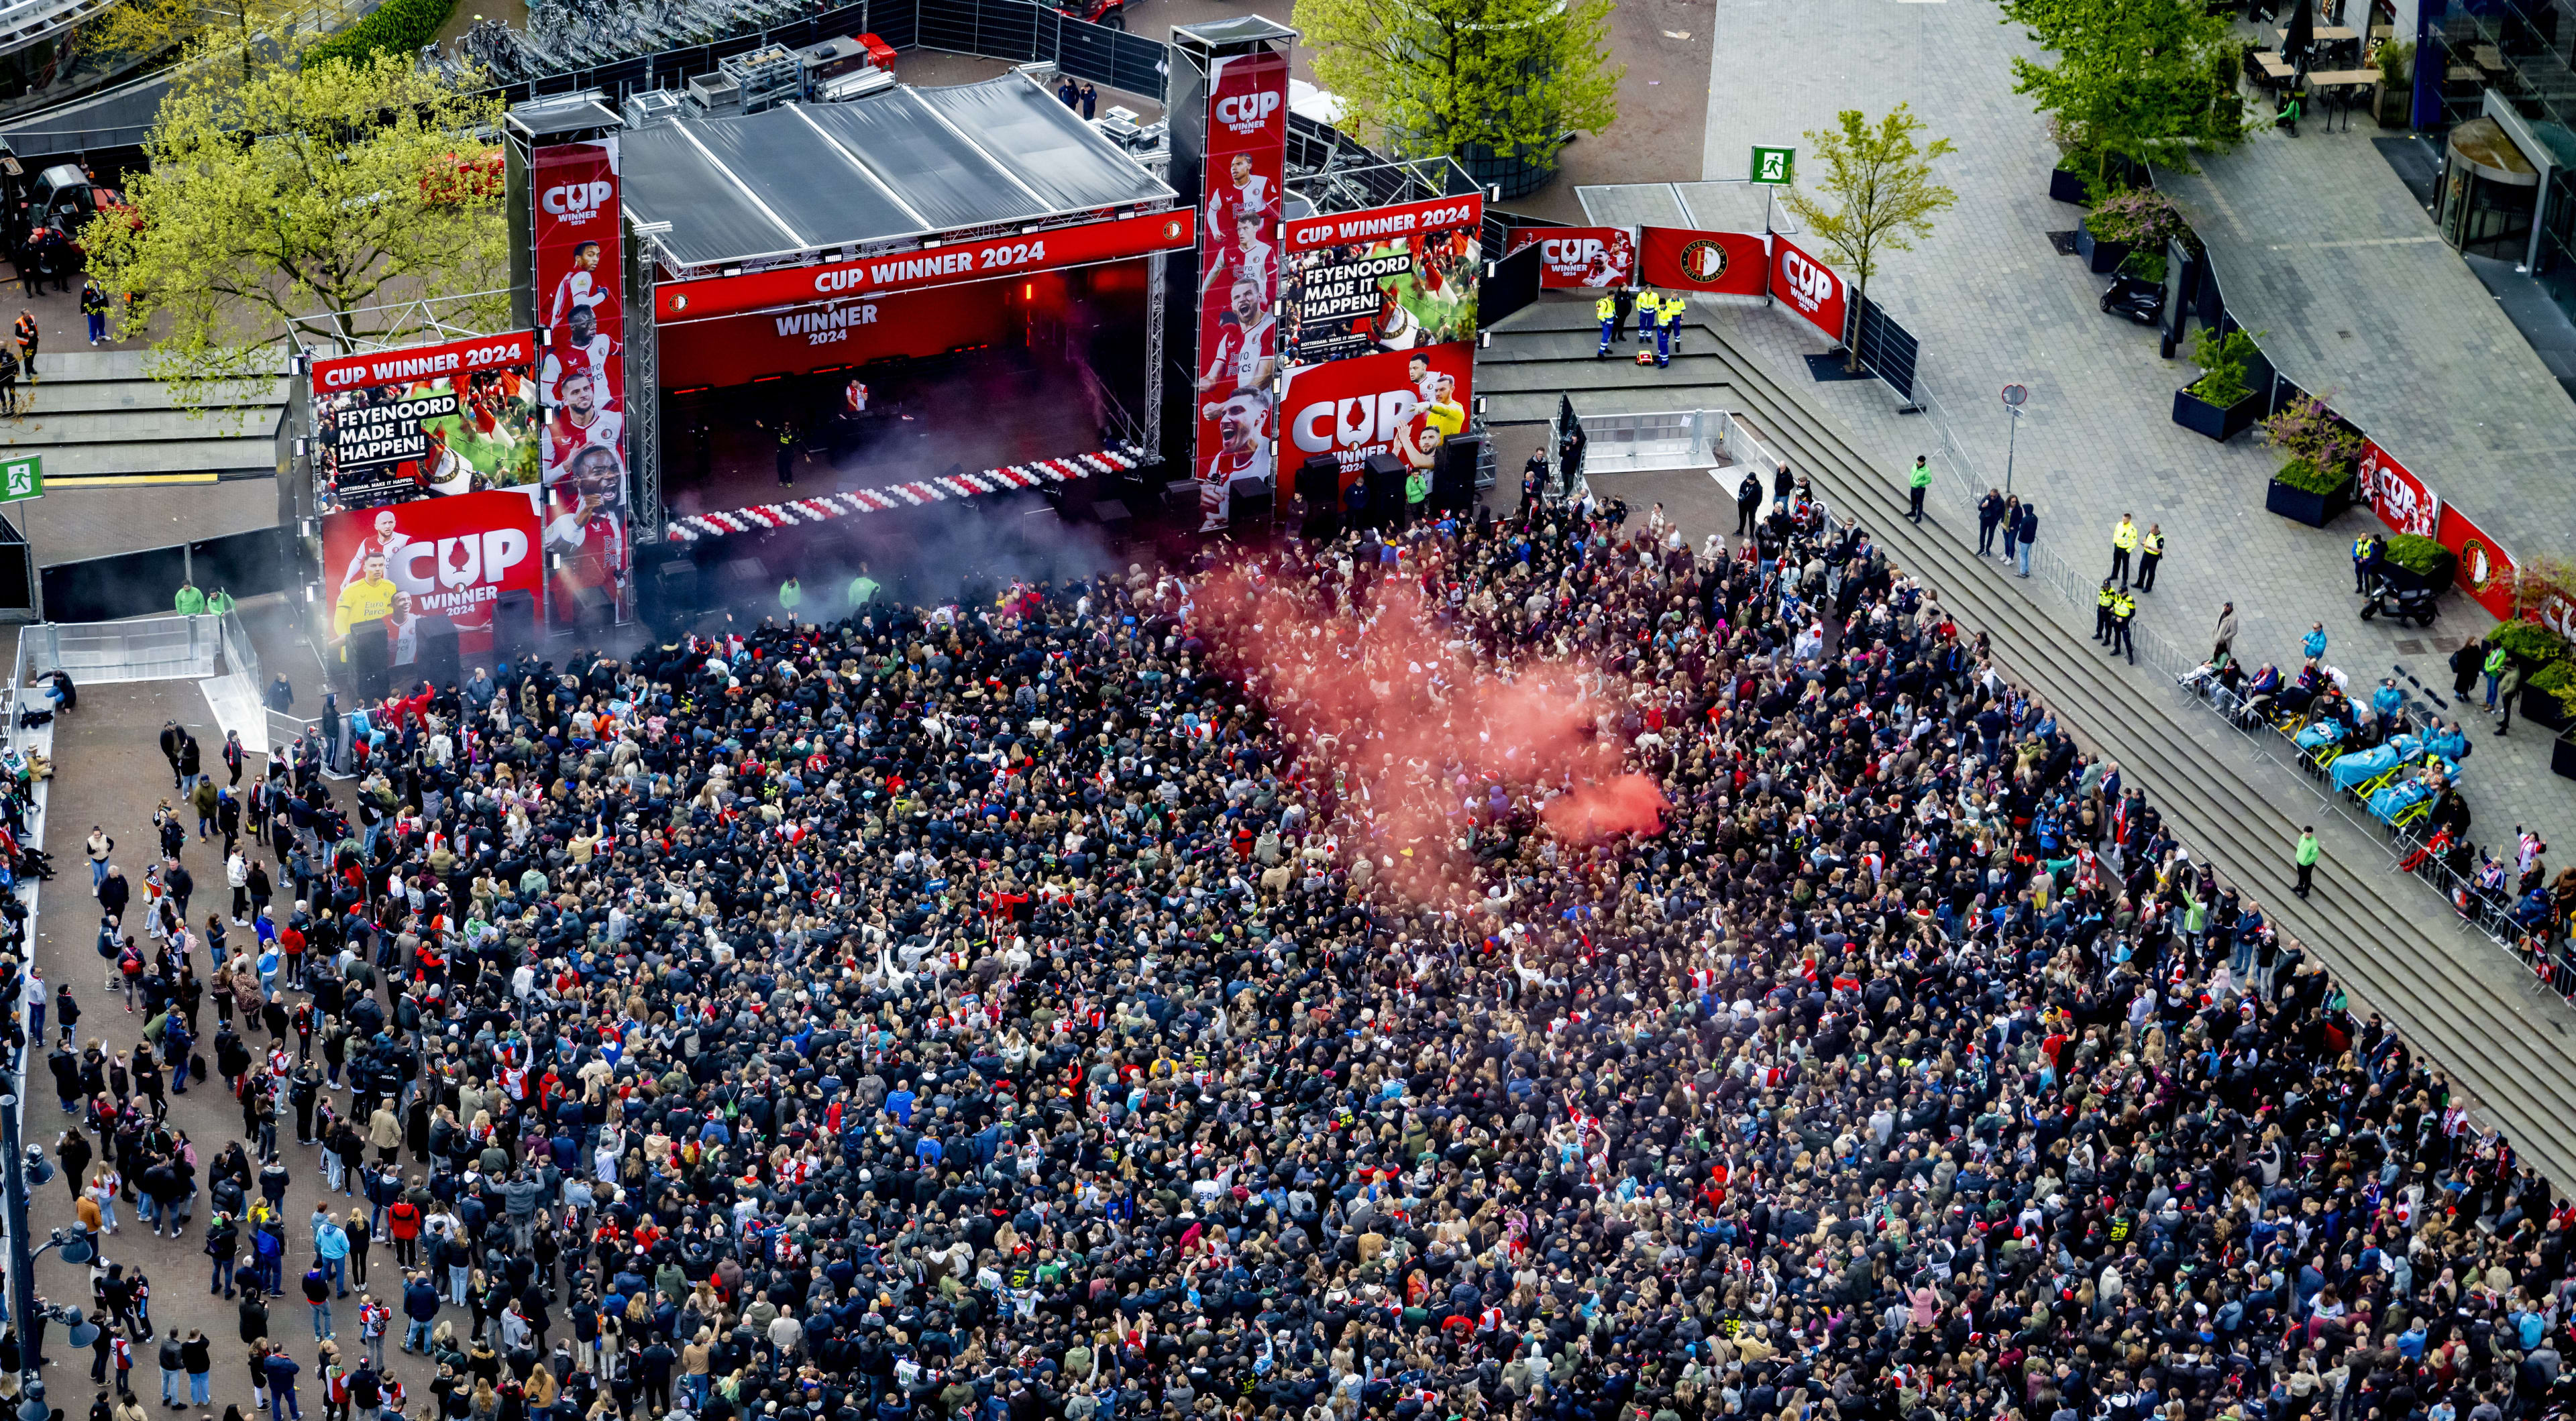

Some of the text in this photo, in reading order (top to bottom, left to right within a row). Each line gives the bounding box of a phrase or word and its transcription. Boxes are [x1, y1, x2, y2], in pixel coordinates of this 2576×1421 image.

[1216, 91, 1280, 124] CUP
[1229, 119, 1265, 132] WINNER
[542, 181, 612, 214] CUP
[558, 211, 597, 223] WINNER
[1296, 205, 1470, 245] CUP WINNER 2024
[1544, 239, 1604, 264] CUP
[1684, 241, 1725, 256] FEYENOORD
[815, 240, 1045, 292] CUP WINNER 2024
[1305, 256, 1409, 285] FEYENOORD
[1551, 264, 1587, 272] WINNER
[1684, 265, 1723, 281] ROTTERDAM
[1781, 250, 1833, 305] CUP
[1305, 278, 1375, 301] MADE IT
[1790, 286, 1819, 313] WINNER
[1304, 293, 1380, 318] HAPPEN!
[1798, 300, 1810, 313] 2024
[775, 304, 878, 337] WINNER
[808, 329, 847, 345] 2024
[1301, 339, 1328, 347] ROTTERDAM.
[1348, 333, 1366, 341] HAPPEN.
[325, 343, 522, 386] CUP WINNER 2024
[338, 397, 455, 427] FEYENOORD
[1292, 390, 1418, 453] CUP
[339, 420, 417, 445] MADE IT
[339, 435, 425, 462] HAPPEN!
[2379, 467, 2417, 511] CUP
[2383, 497, 2406, 521] WINNER
[388, 528, 529, 595] CUP
[421, 585, 498, 610] WINNER
[446, 604, 476, 616] 2024
[2110, 1227, 2128, 1238] 29
